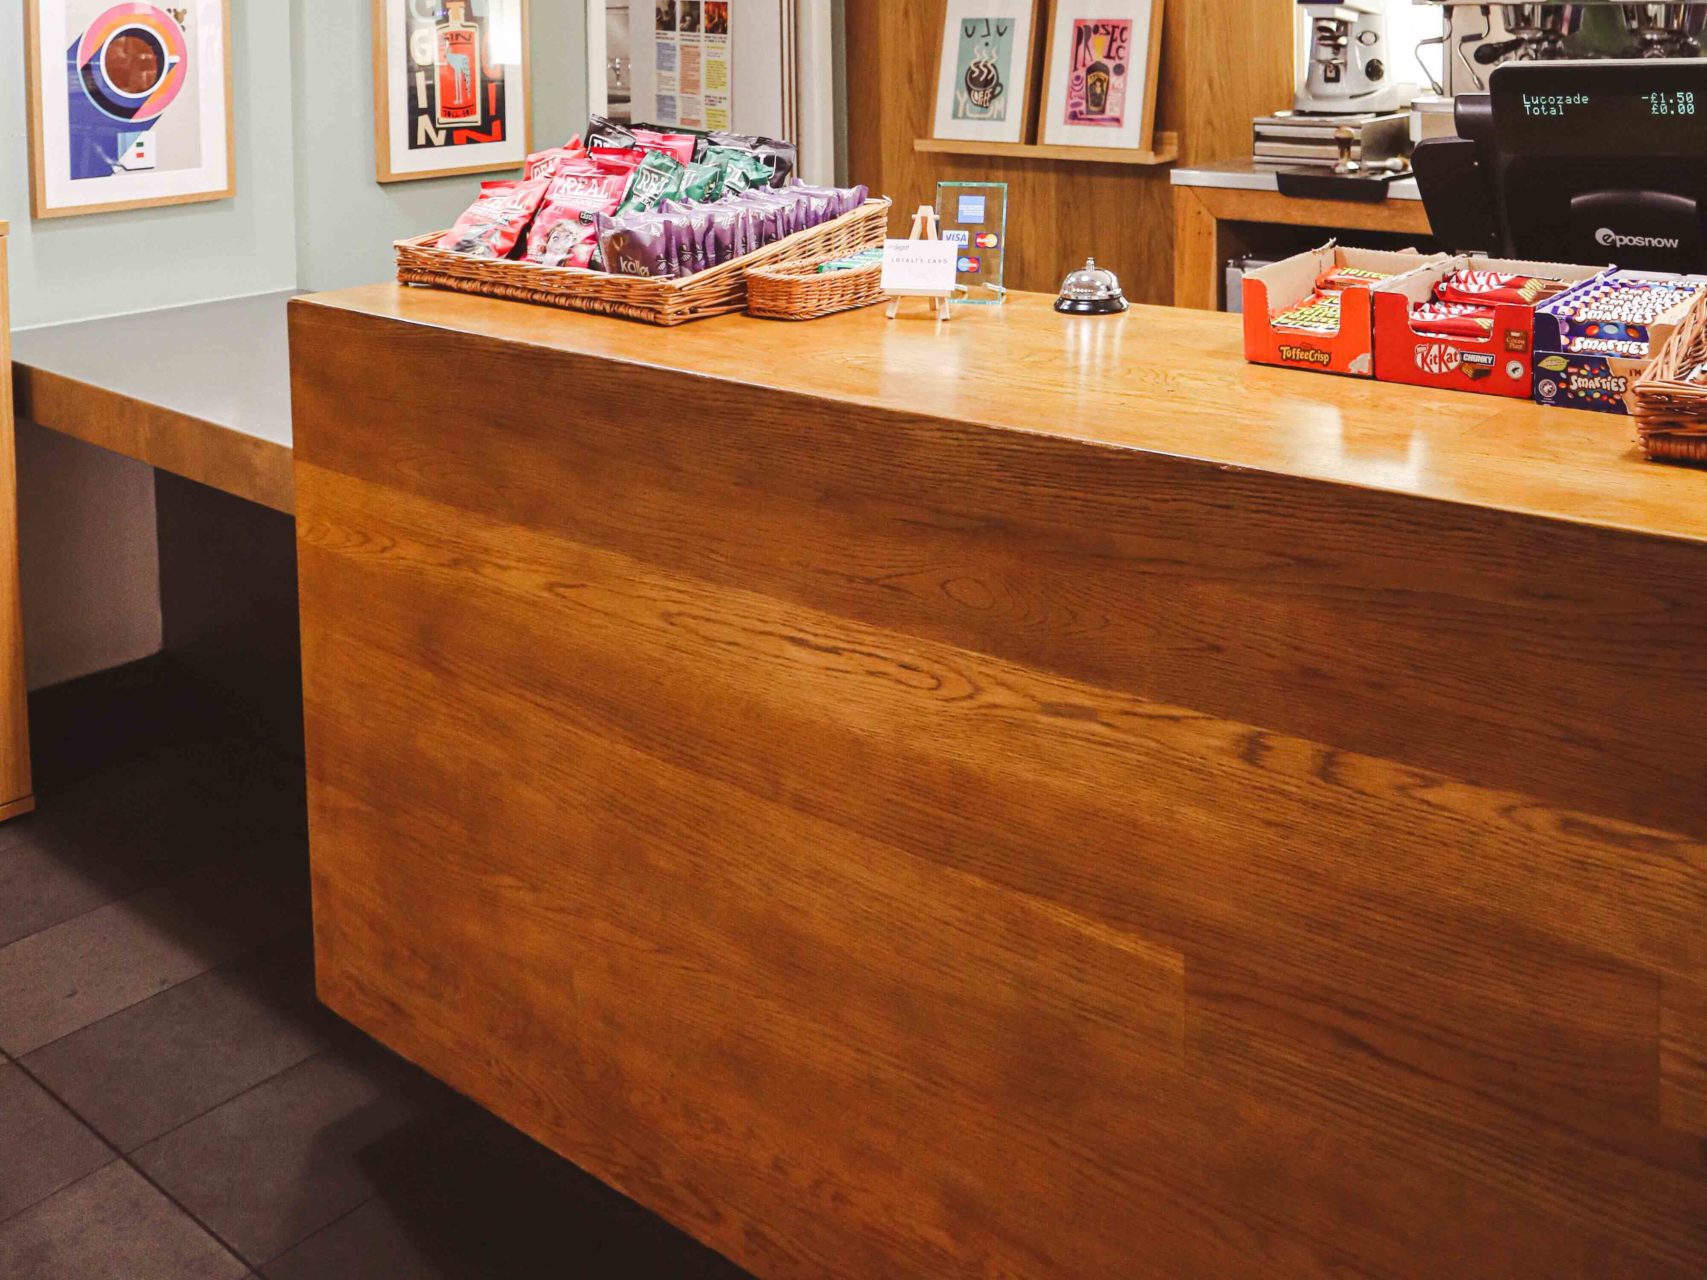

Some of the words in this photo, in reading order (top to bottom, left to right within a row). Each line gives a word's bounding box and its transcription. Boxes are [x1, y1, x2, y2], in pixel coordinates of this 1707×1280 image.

[1522, 93, 1589, 105] Lucozade
[1641, 92, 1694, 104] -£1.50
[1524, 104, 1564, 115] Total
[1651, 103, 1695, 115] £0.00
[559, 176, 609, 198] REAL
[945, 233, 967, 243] VISA
[1595, 227, 1679, 248] eposnow
[1463, 353, 1493, 365] CHUNKY
